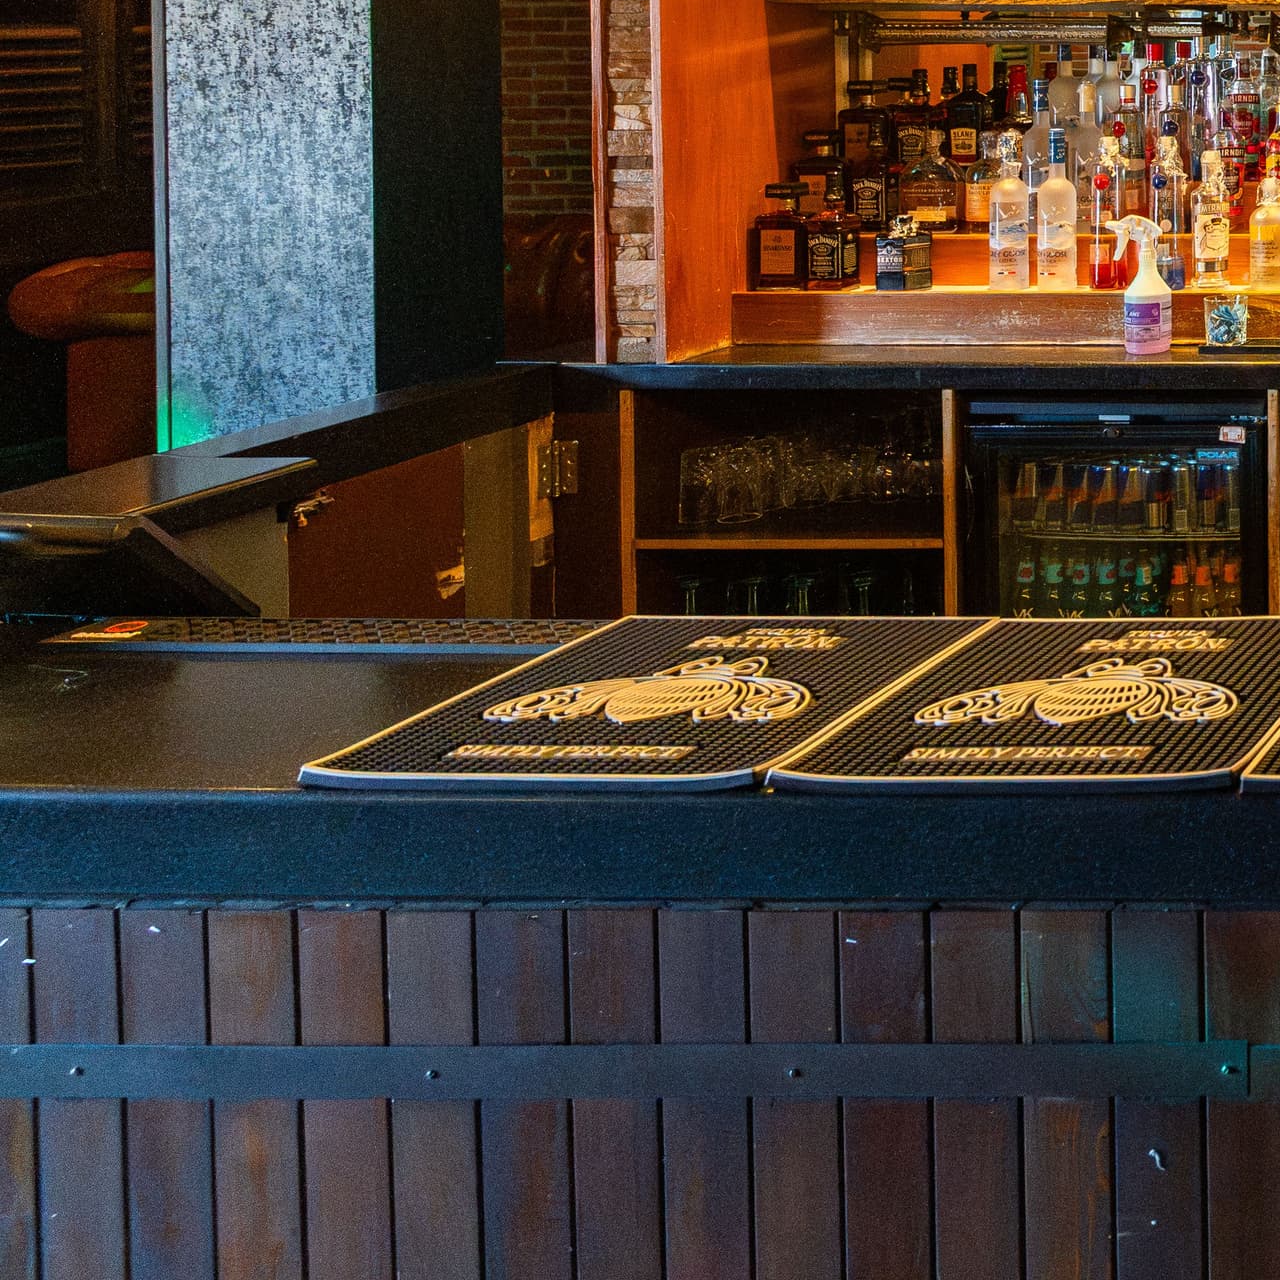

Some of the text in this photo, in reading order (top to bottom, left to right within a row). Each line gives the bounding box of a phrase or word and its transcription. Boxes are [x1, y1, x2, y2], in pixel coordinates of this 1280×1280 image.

[1198, 451, 1238, 459] POLAR
[746, 627, 827, 635] TEQUILA
[1128, 629, 1207, 638] TEQUILA
[449, 745, 557, 758] SIMPLY
[906, 747, 1010, 760] SIMPLY
